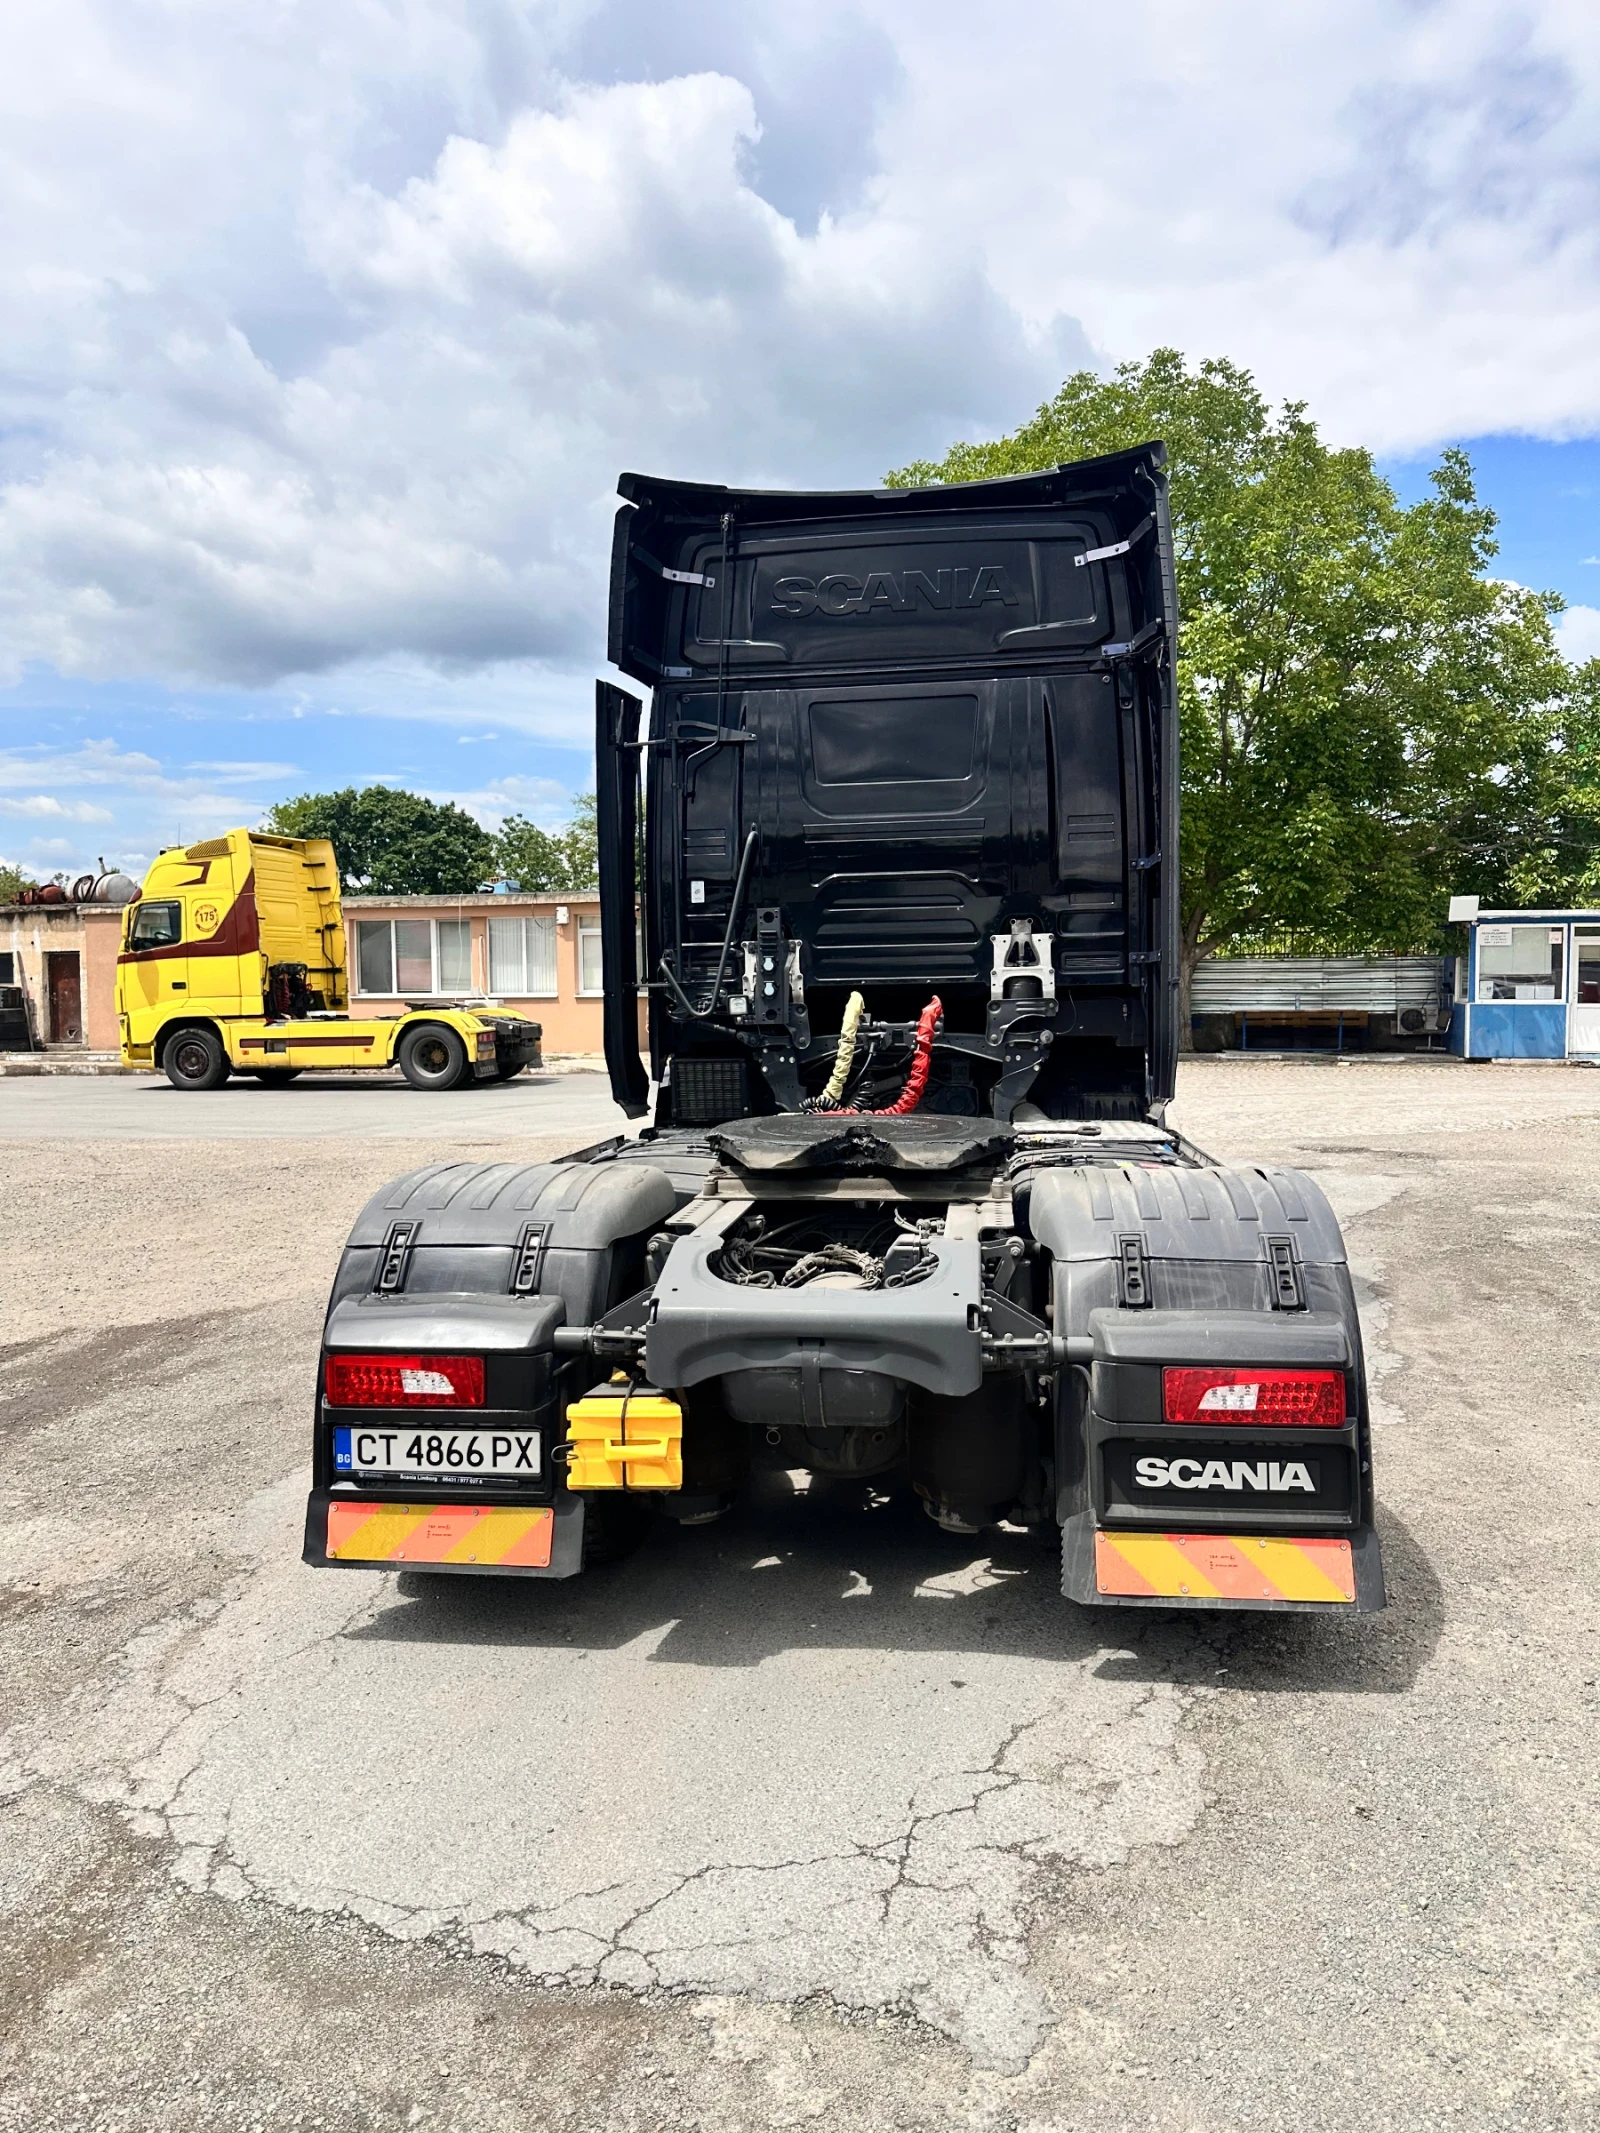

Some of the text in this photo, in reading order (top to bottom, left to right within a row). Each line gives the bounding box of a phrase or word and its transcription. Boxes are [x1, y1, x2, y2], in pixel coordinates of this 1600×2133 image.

[771, 566, 1019, 619] SCANIA
[200, 911, 215, 922] 175
[337, 1453, 351, 1463] BG
[357, 1434, 534, 1468] CT 4866 PX
[1135, 1457, 1316, 1492] SCANIA
